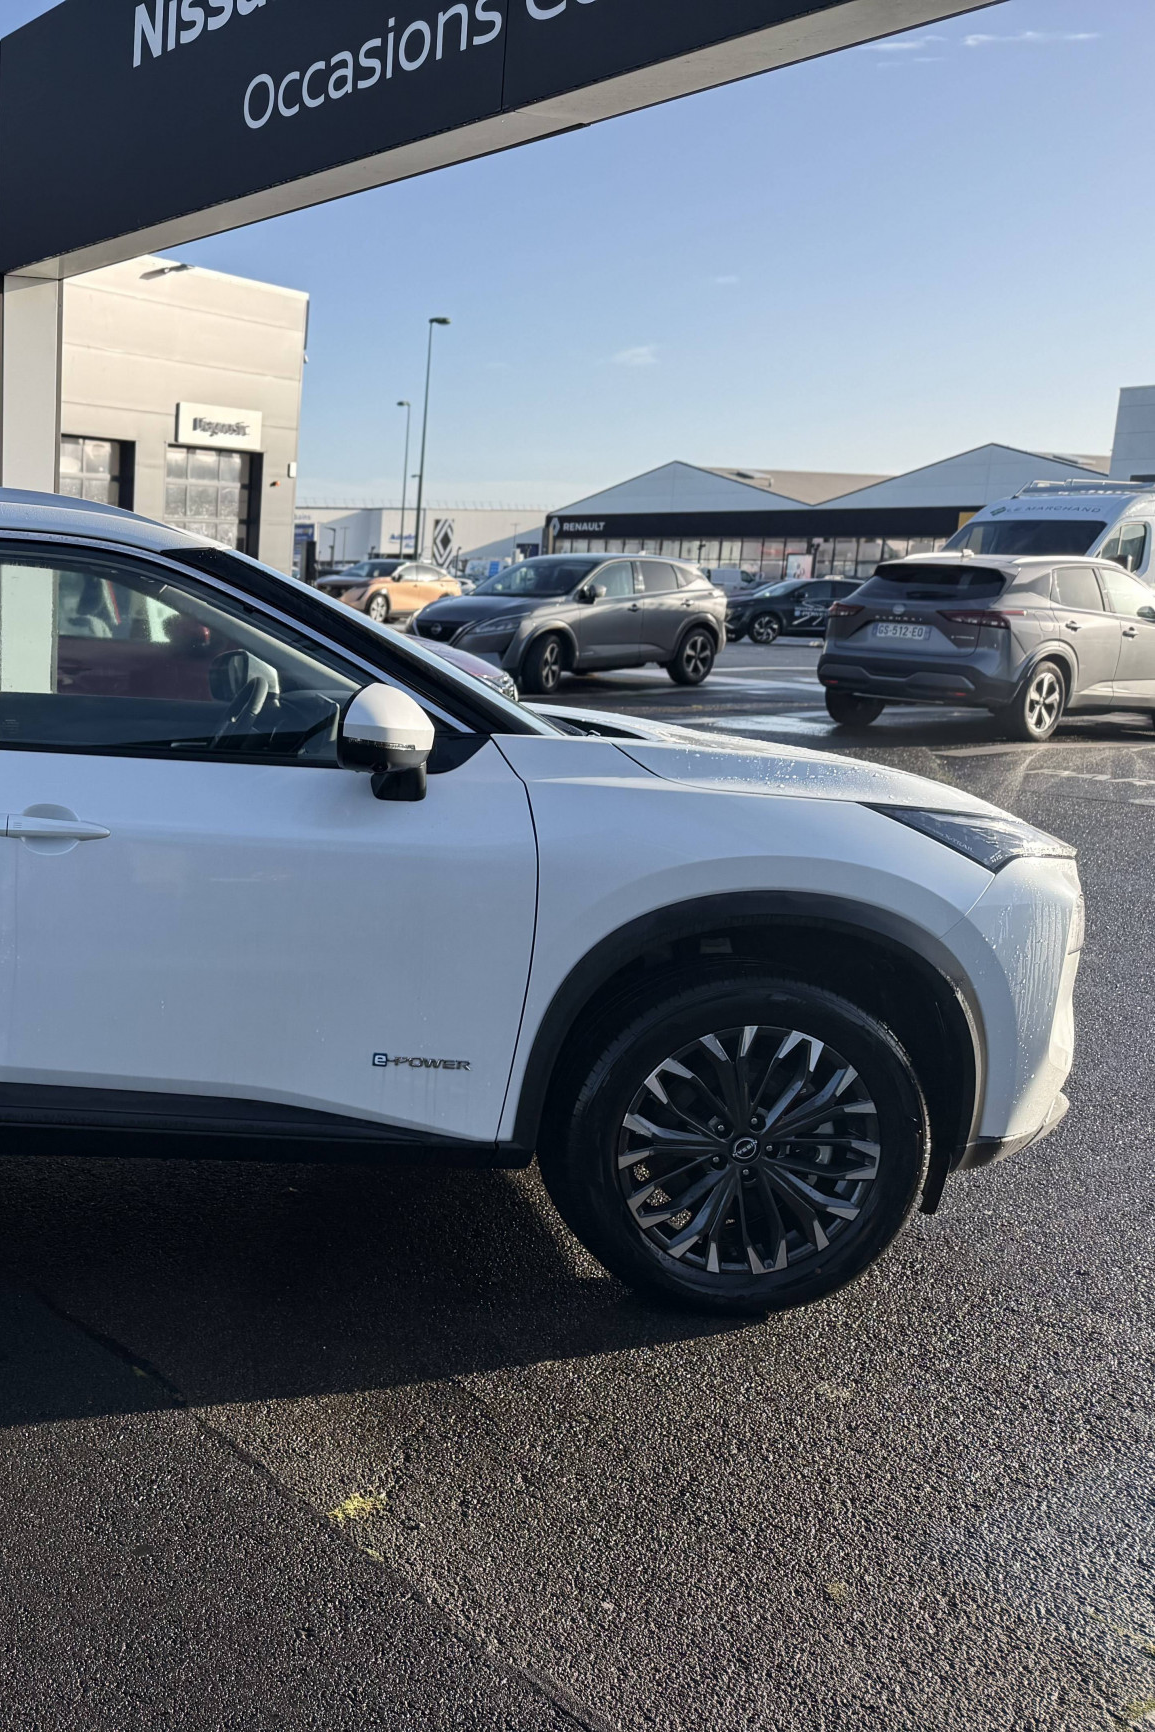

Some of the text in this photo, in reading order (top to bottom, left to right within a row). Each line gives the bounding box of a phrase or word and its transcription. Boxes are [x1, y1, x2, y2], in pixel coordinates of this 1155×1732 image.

[243, 0, 503, 128] Occasions
[1025, 505, 1101, 513] MARCHAND
[563, 522, 605, 531] RENAULT
